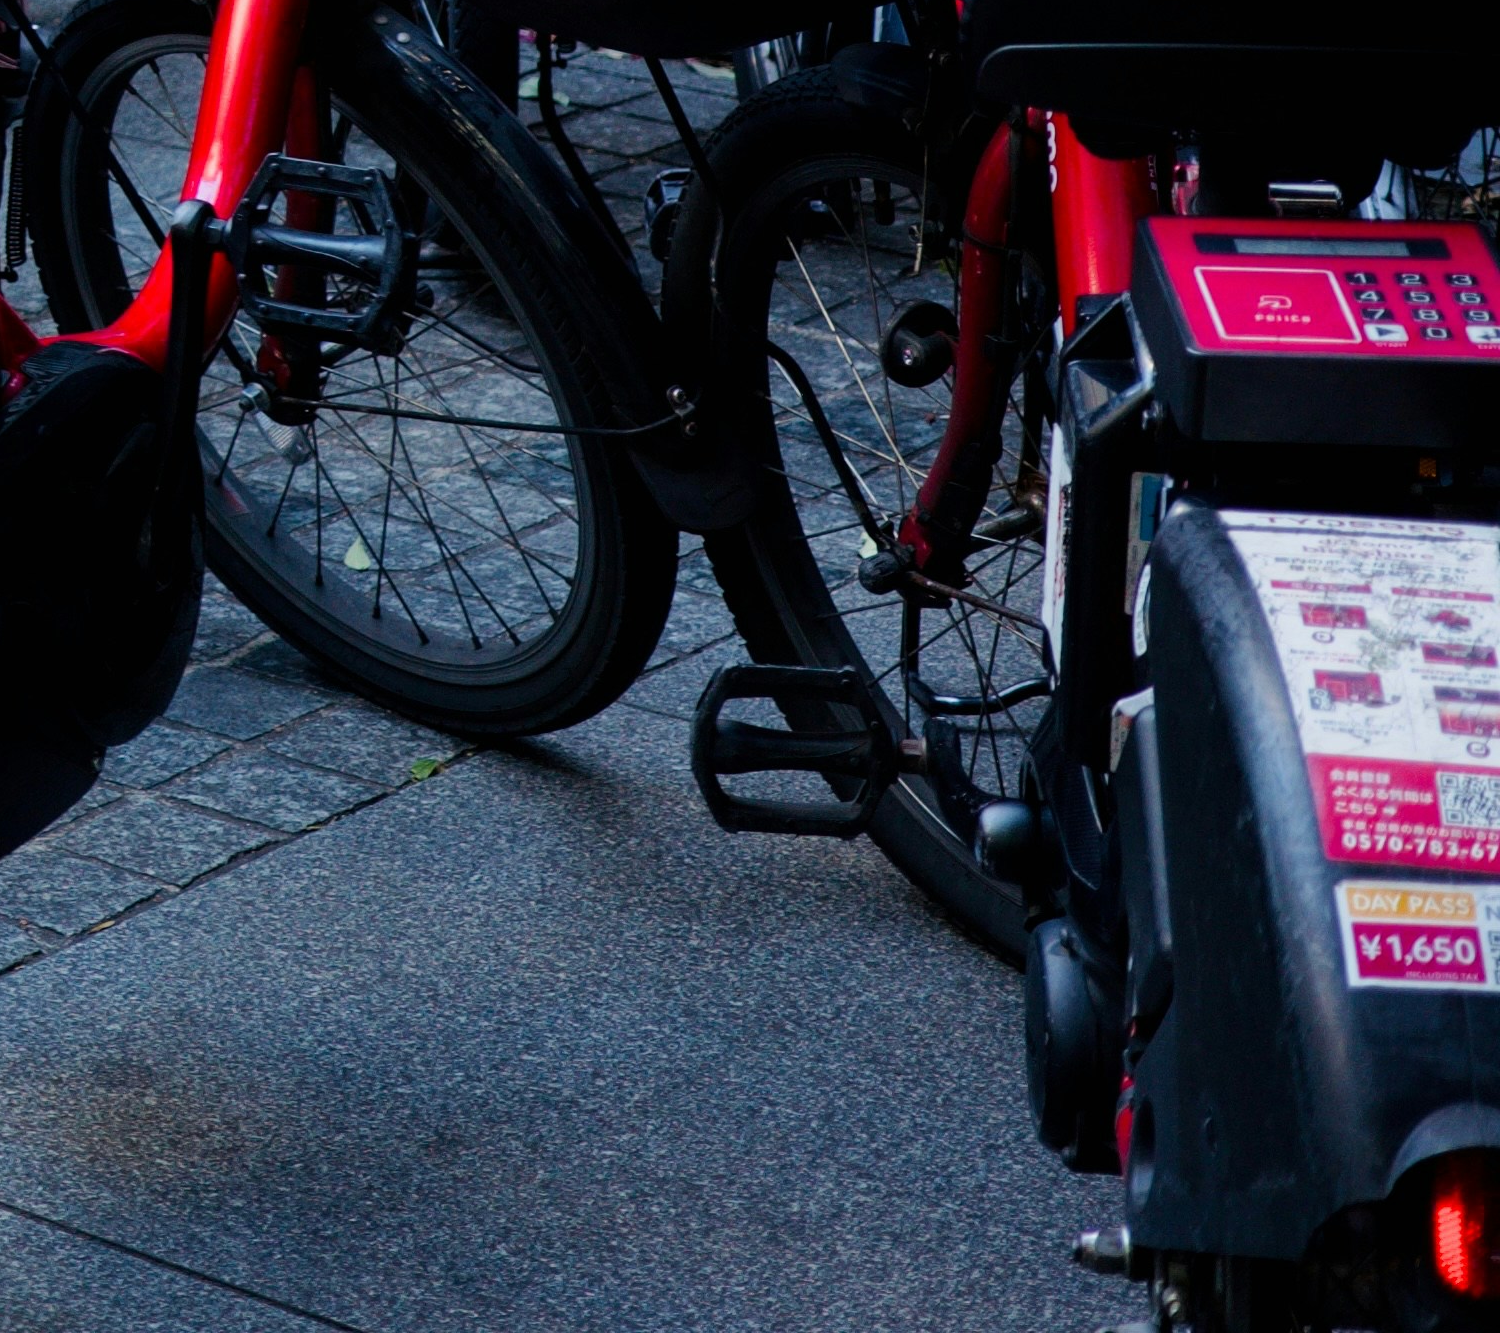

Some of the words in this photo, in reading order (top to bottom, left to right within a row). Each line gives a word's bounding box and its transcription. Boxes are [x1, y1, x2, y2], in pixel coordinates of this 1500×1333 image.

[1353, 273, 1367, 284] 1
[1401, 273, 1421, 284] 2
[1451, 274, 1473, 285] 3
[1359, 291, 1379, 302] 4
[1409, 291, 1430, 302] 5
[1459, 292, 1482, 303] 6
[1367, 308, 1385, 320] 7
[1418, 309, 1439, 321] 8
[1468, 310, 1490, 322] 9
[1426, 327, 1448, 339] 0
[1352, 893, 1402, 913] DAY
[1408, 895, 1471, 916] PASS
[1359, 933, 1477, 967] ¥1,650
